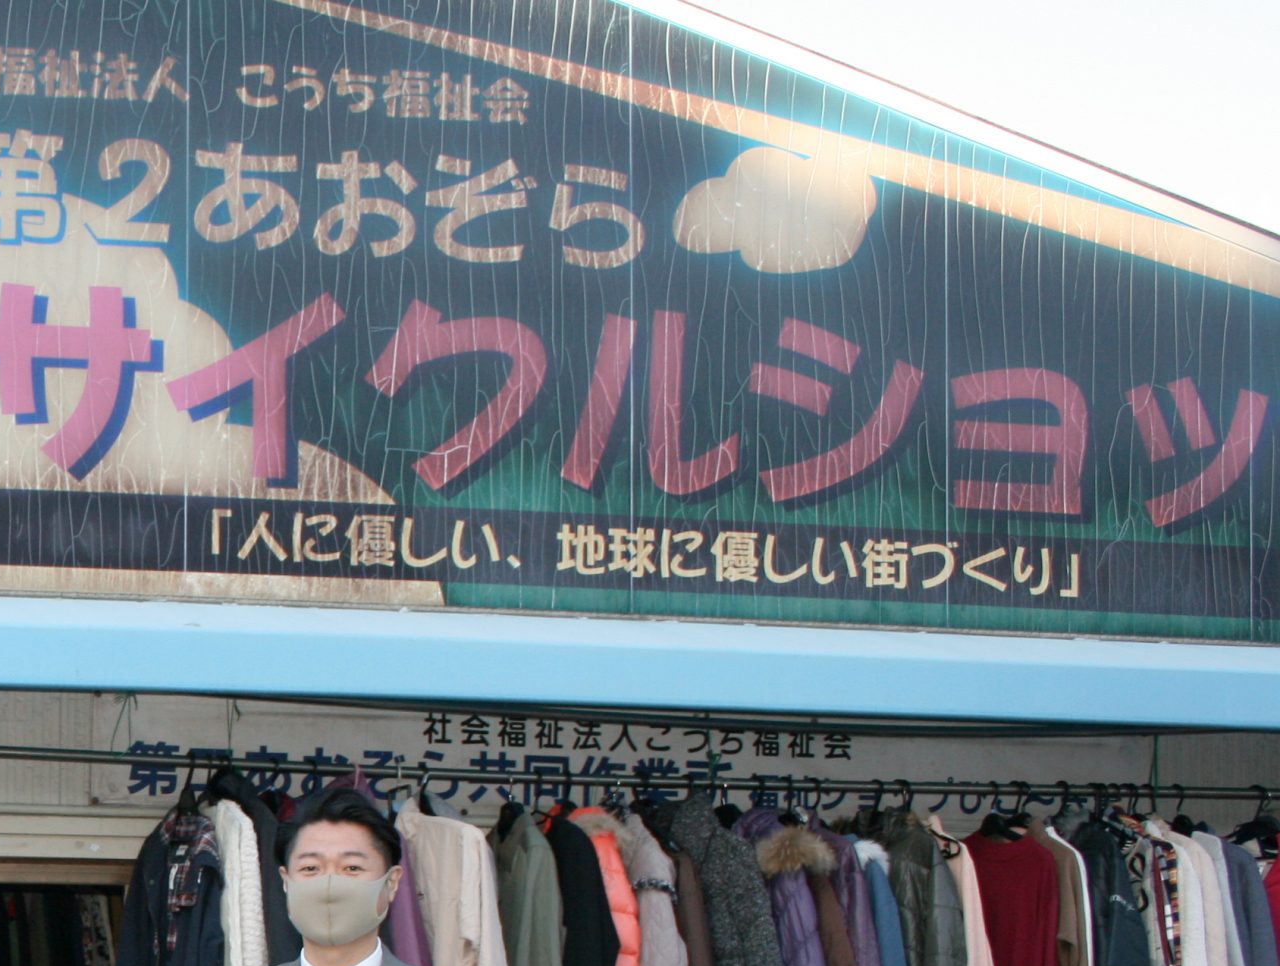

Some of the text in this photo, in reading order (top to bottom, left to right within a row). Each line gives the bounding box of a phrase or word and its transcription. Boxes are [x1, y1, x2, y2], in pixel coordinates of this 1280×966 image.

[235, 64, 530, 126] こうち福祉会
